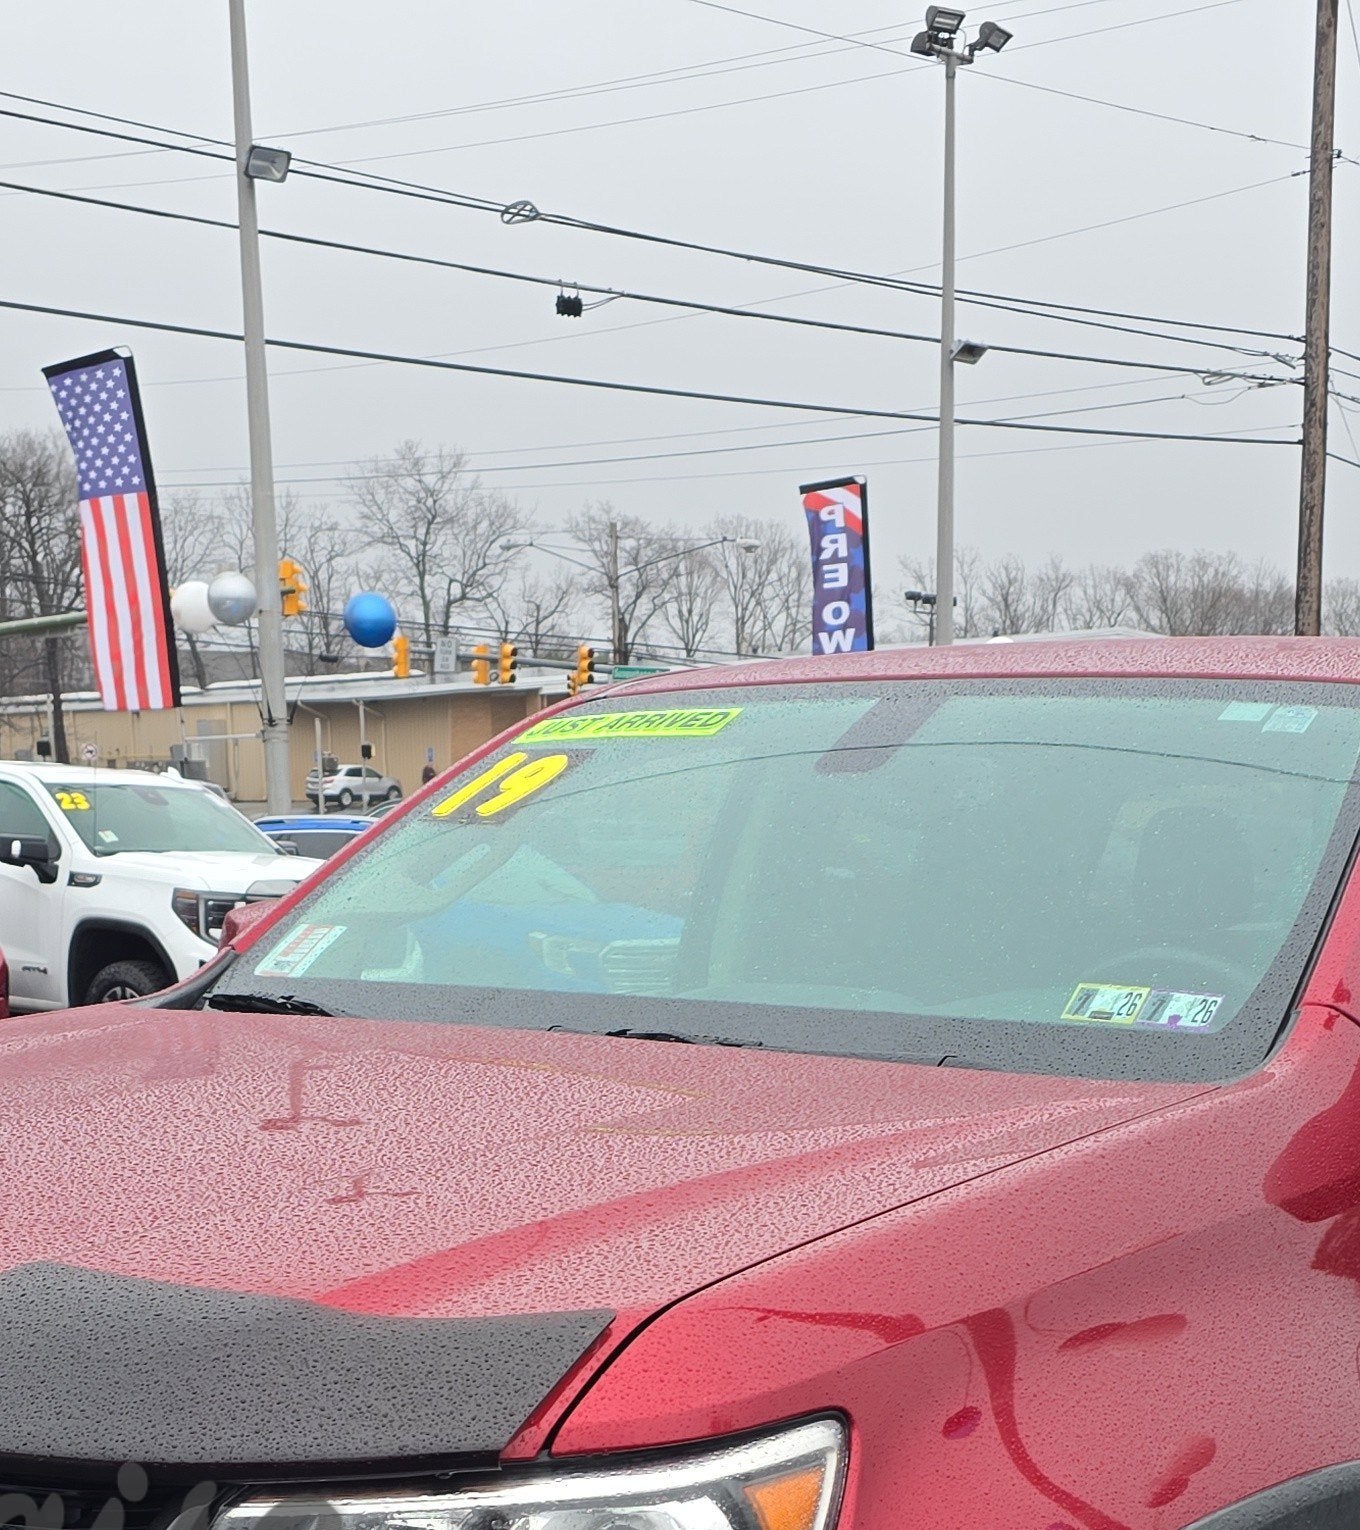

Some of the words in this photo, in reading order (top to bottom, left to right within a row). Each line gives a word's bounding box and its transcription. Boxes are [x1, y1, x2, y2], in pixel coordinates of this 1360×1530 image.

[528, 717, 600, 736] JUST
[603, 711, 732, 731] ARRIVED
[431, 752, 569, 817] 19
[55, 792, 91, 811] 23
[1116, 991, 1143, 1017] 26
[1191, 998, 1219, 1024] 26
